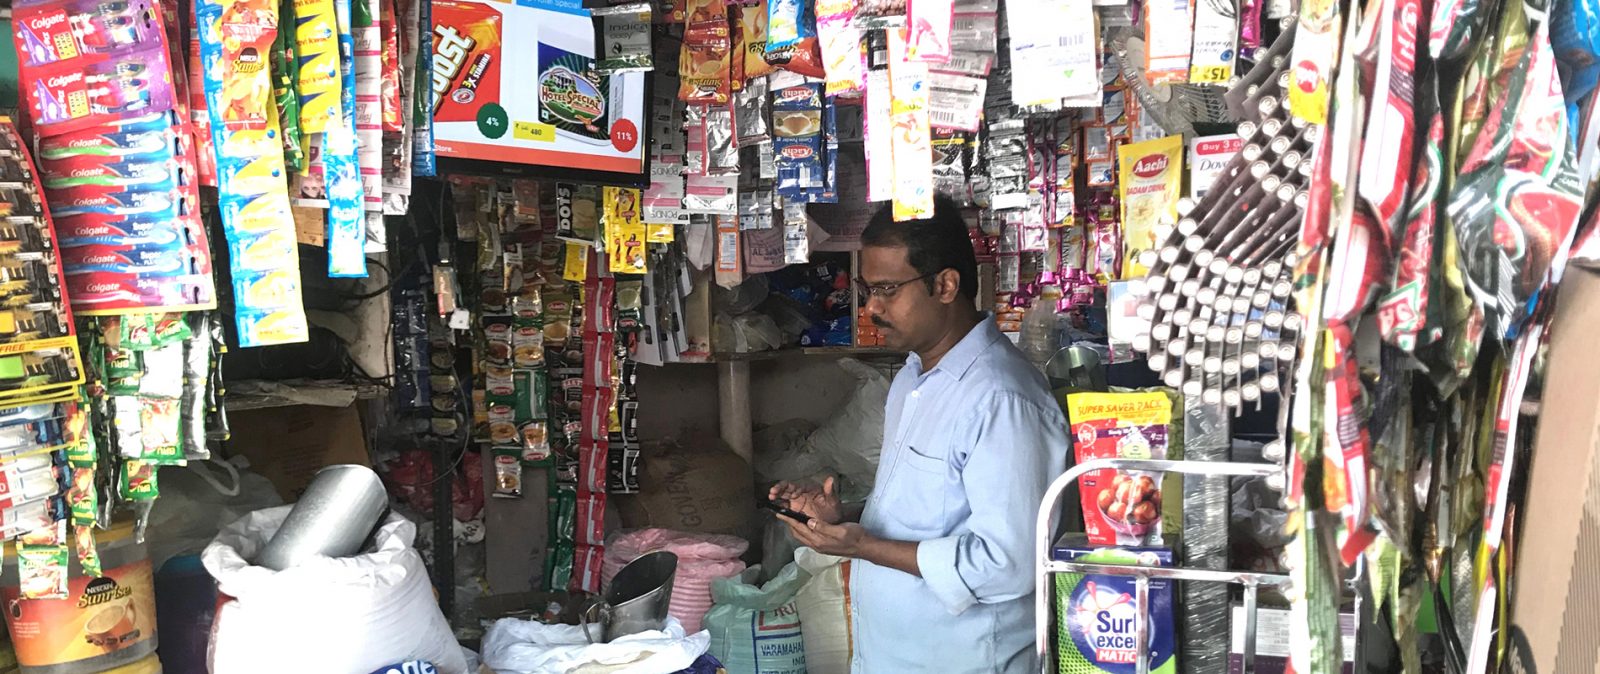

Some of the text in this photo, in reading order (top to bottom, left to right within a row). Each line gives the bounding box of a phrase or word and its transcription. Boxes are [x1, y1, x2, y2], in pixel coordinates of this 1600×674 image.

[31, 13, 65, 29] Colgate
[432, 24, 473, 109] oost
[48, 72, 83, 88] Colgate
[1211, 68, 1226, 80] 15
[485, 116, 499, 127] 4%
[616, 131, 632, 141] 11%
[69, 138, 102, 148] Colgate
[1201, 143, 1219, 151] Buy
[1134, 155, 1169, 173] Aachi
[70, 167, 105, 178] Colgate
[73, 196, 108, 206] Colgate
[559, 188, 571, 228] DOTS
[75, 226, 110, 236] Colgate
[83, 254, 117, 264] Colgate
[86, 282, 121, 294] Colgate
[1078, 405, 1104, 416] SUPER
[1105, 403, 1135, 412] SAVER
[77, 585, 132, 608] Sunrise
